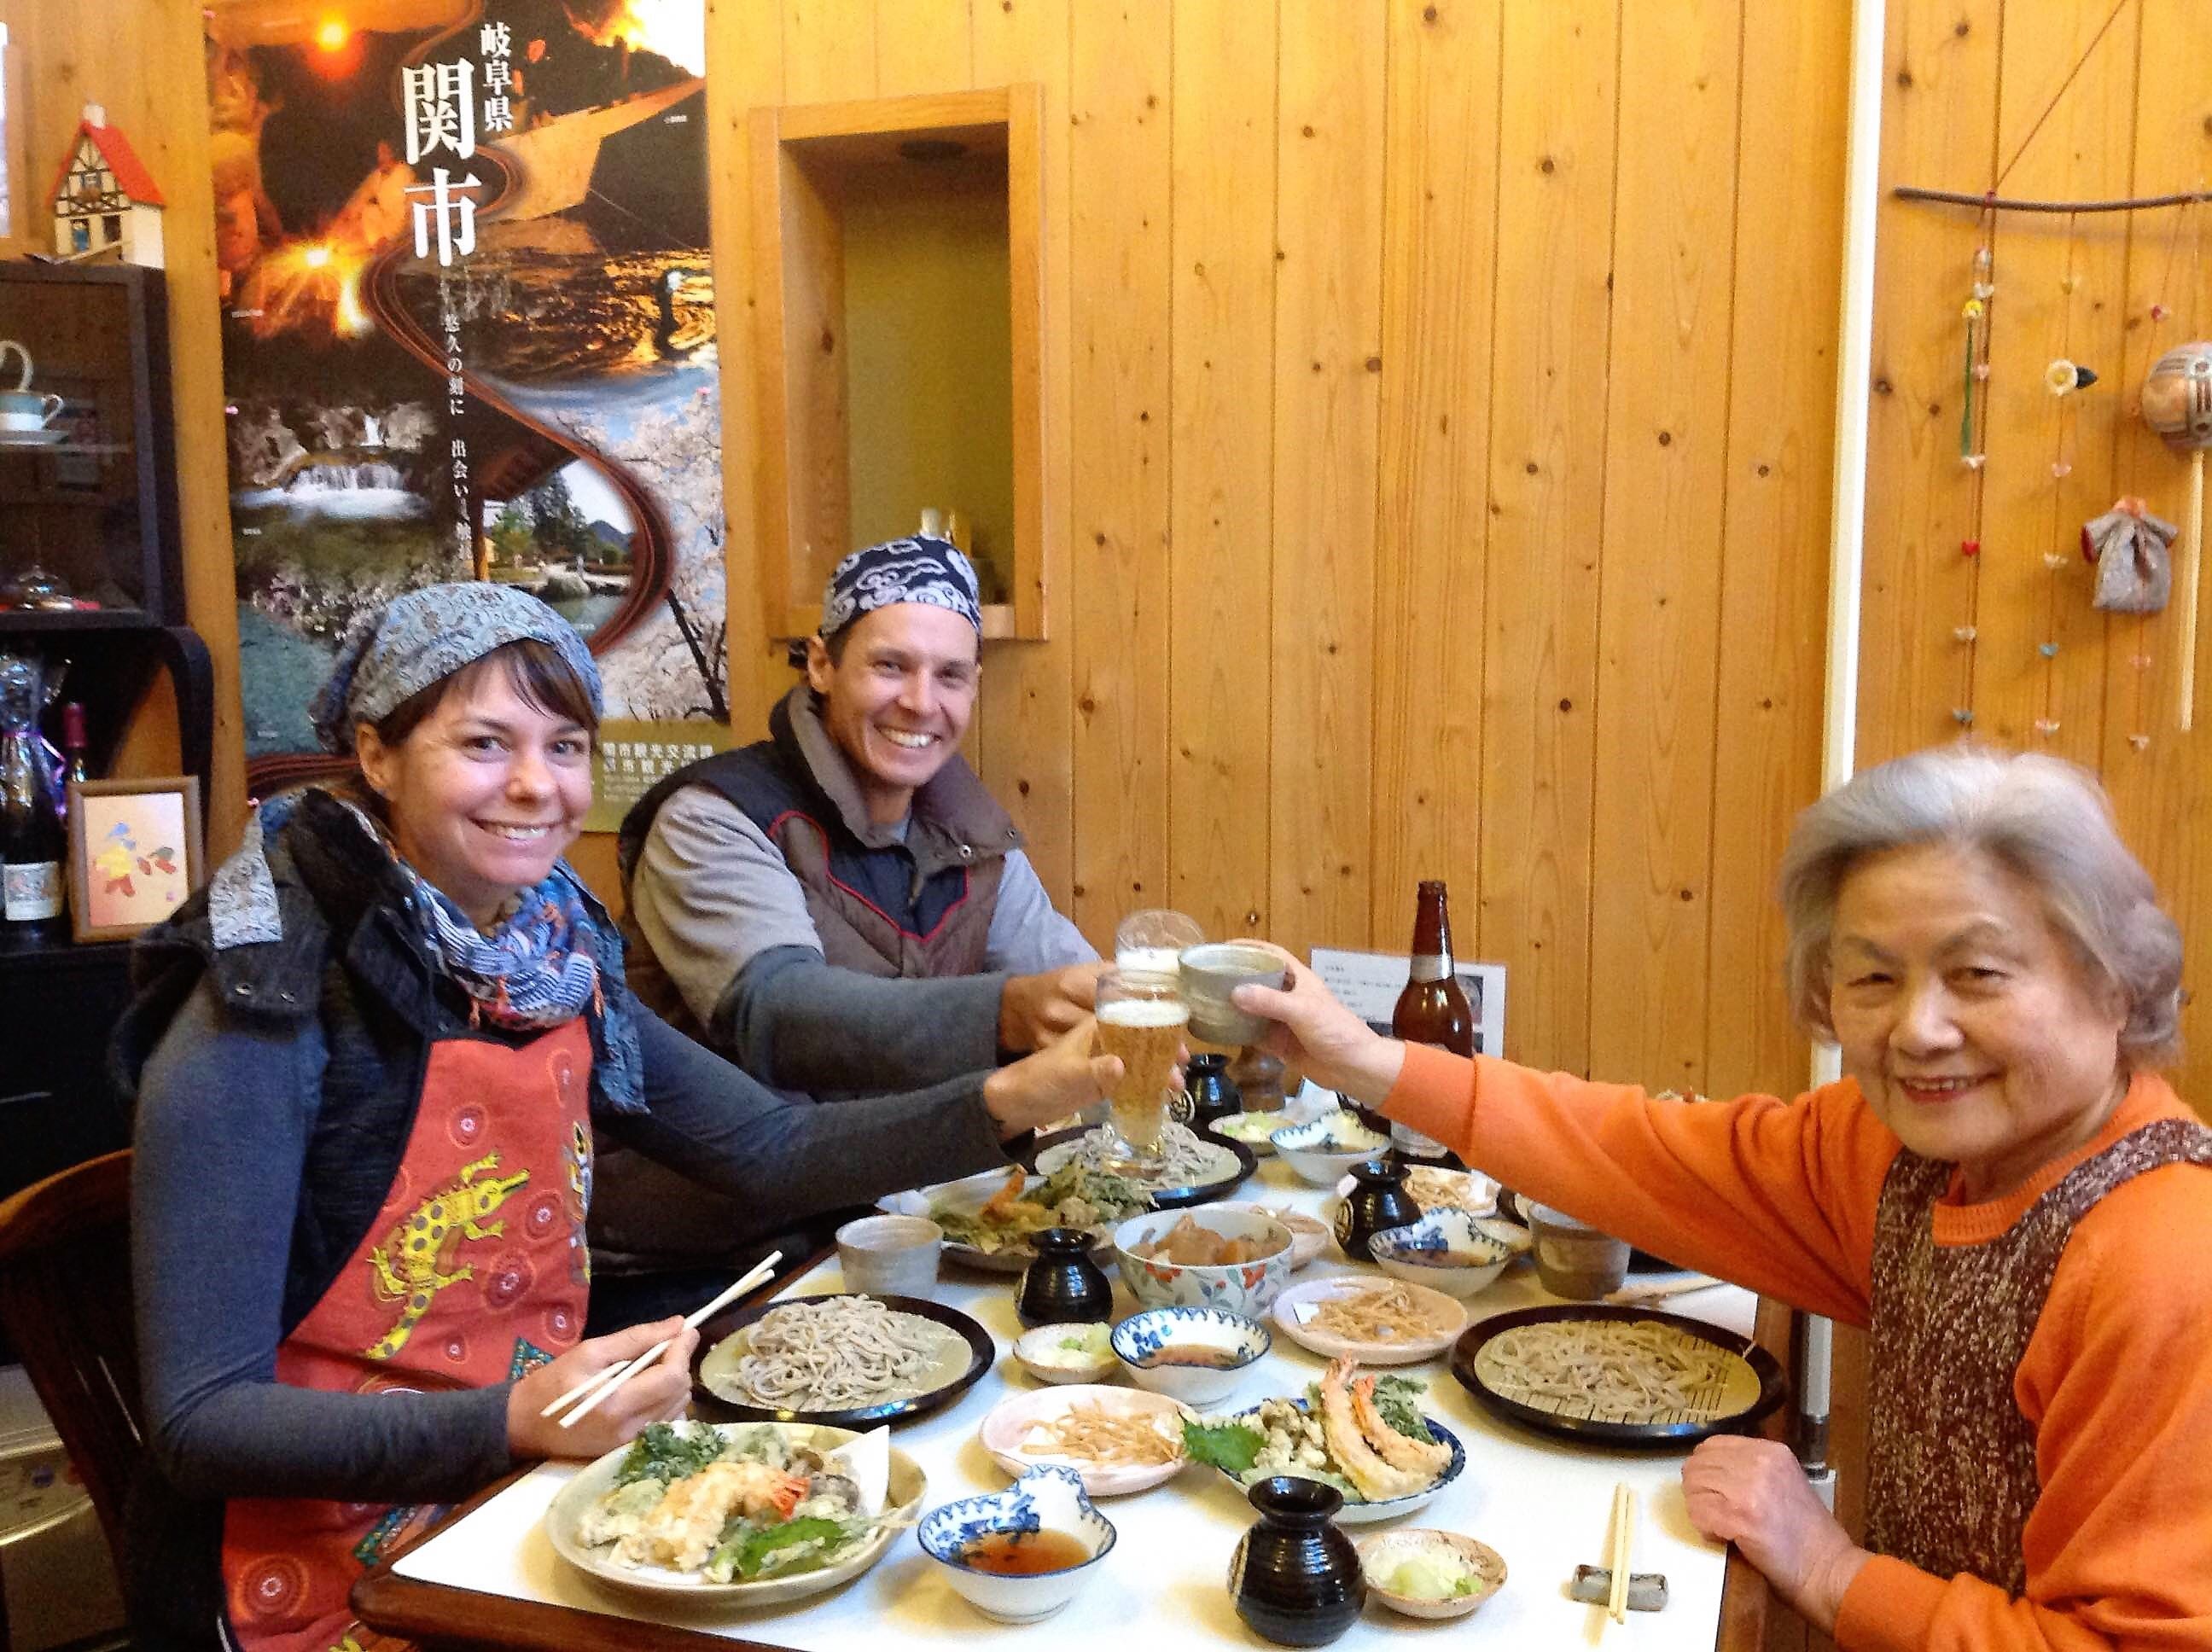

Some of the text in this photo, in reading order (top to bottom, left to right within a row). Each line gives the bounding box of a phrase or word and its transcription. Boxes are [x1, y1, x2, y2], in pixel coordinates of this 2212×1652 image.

[480, 21, 514, 131] 岐阜県
[402, 57, 482, 267] 関市
